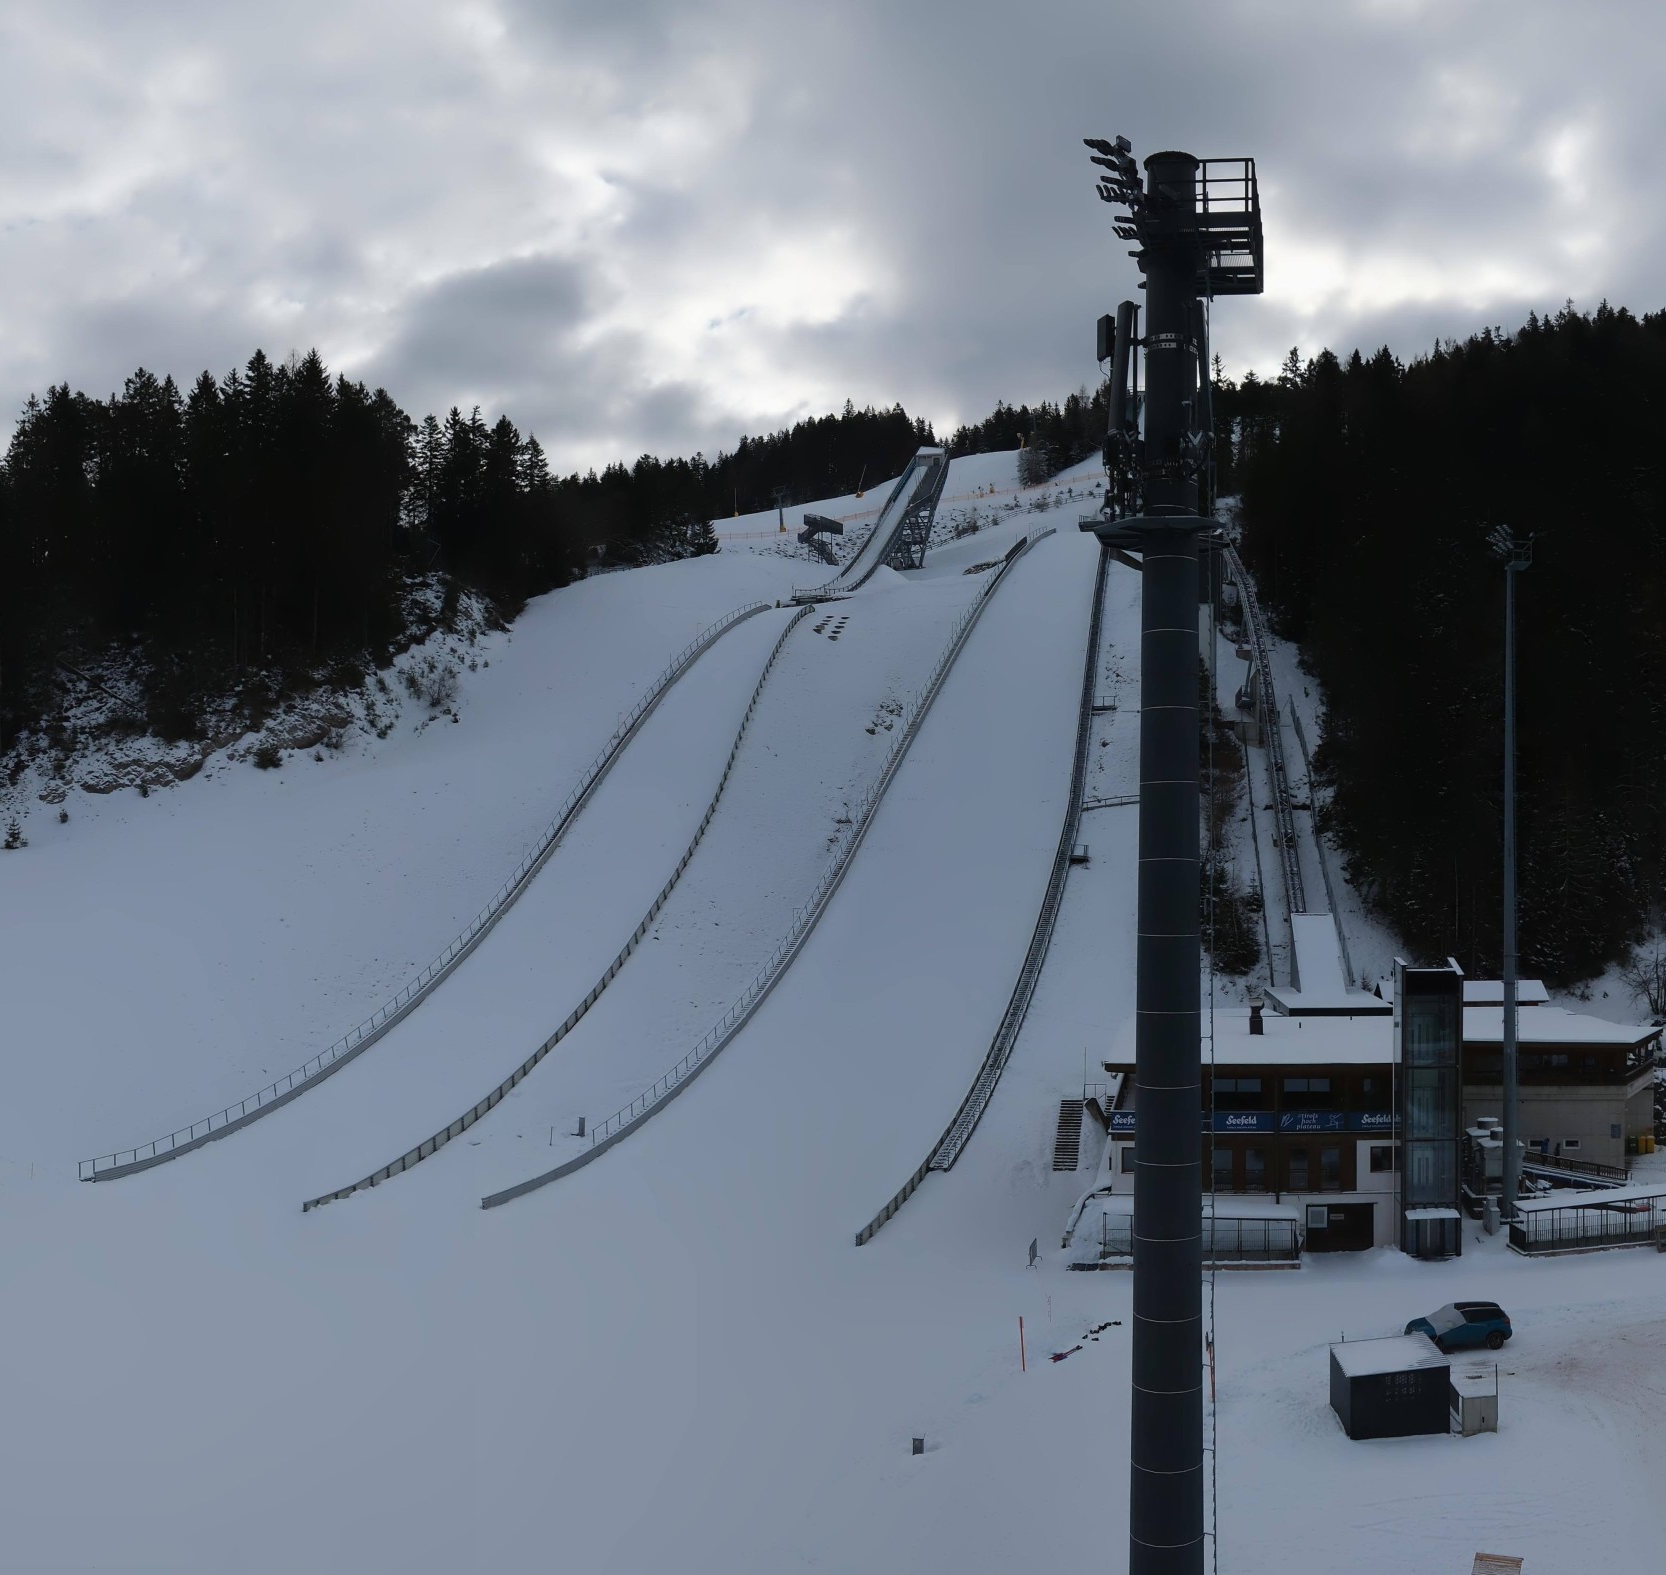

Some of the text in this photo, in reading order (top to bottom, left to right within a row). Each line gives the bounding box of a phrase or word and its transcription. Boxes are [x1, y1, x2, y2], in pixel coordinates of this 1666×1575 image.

[1112, 1114, 1136, 1126] Seefe
[1226, 1114, 1257, 1126] Seefeld
[1361, 1113, 1392, 1125] Seefeld
[1296, 1123, 1321, 1131] plateau
